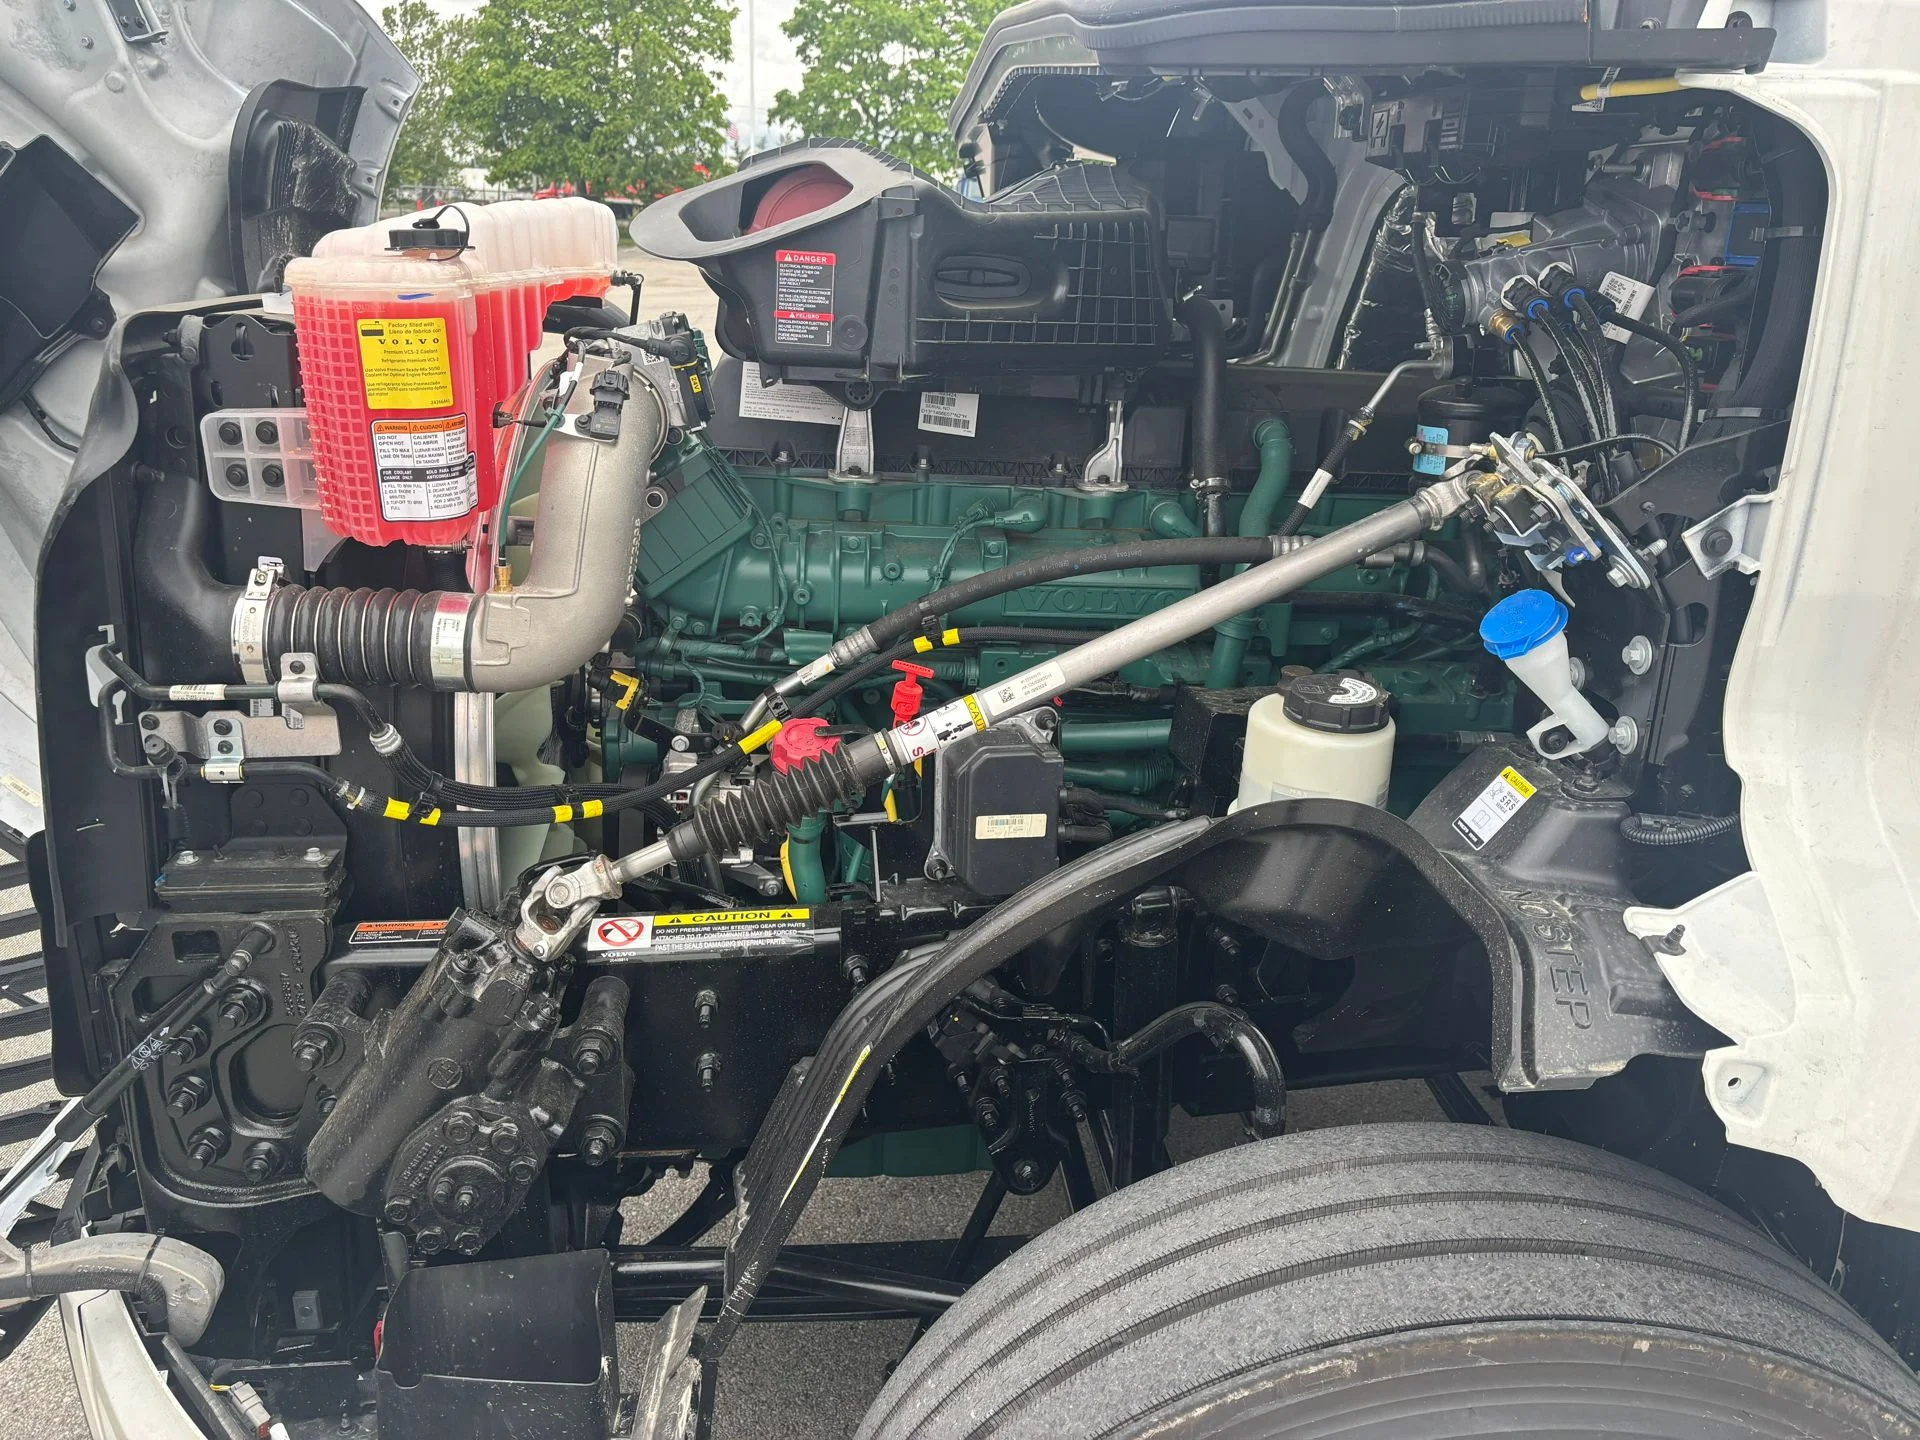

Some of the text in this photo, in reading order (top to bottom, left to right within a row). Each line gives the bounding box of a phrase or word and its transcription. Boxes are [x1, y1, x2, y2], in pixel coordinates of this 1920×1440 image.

[690, 376, 700, 391] 24V
[1510, 776, 1529, 794] CAUTION
[1500, 796, 1515, 811] SRS
[692, 912, 770, 922] CAUTION
[1498, 888, 1592, 1030] NO STEP
